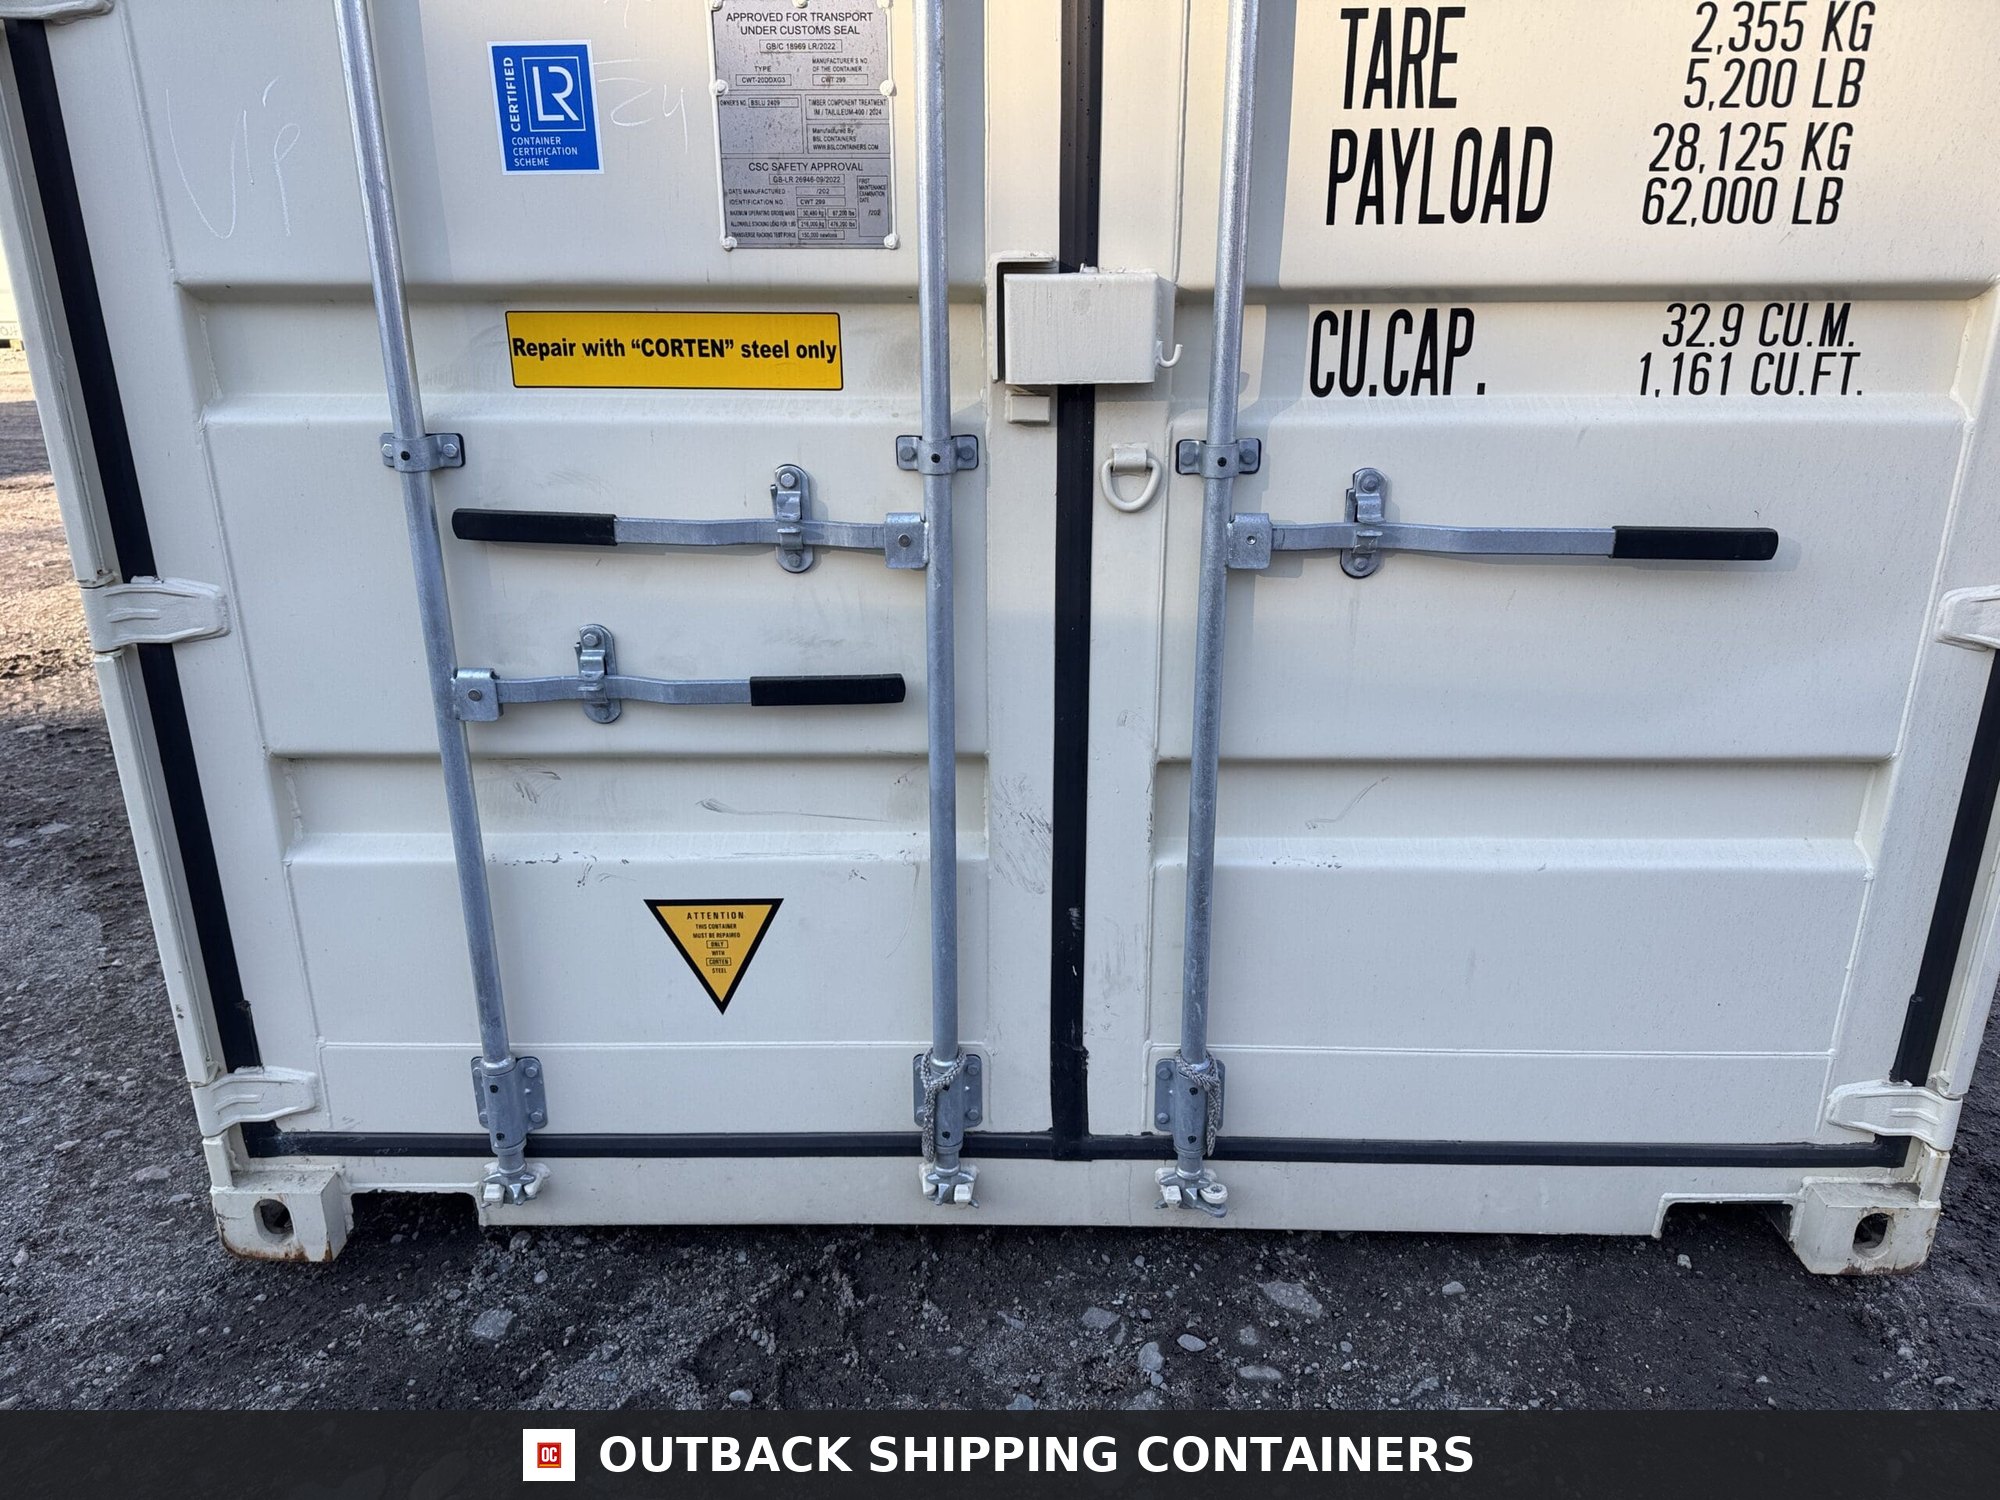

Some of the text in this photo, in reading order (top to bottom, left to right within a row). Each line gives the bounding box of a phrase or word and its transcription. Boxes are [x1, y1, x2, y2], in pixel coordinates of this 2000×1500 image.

[726, 12, 873, 22] APPROVED FOR TRANSPORT
[740, 26, 860, 35] UNDER CUSTOMS SEAL
[1691, 0, 1876, 55] 2,355 KG
[1340, 6, 1466, 110] TARE
[503, 57, 521, 132] CERTIFIED
[532, 66, 580, 121] LR
[1684, 58, 1864, 111] 5,200 LB
[512, 136, 561, 146] CONTAINER
[513, 147, 578, 156] CERTIFICATION
[514, 157, 549, 167] SCHEME
[1648, 122, 1854, 174] 28,125 KG
[748, 162, 863, 171] CSC SAFETY APPROVAL
[1325, 126, 1553, 226] PAYLOAD
[1642, 177, 1844, 227] 62,000 LB
[1662, 302, 1854, 348] 32.9 CU.M.
[512, 337, 575, 361] Repair
[582, 338, 625, 358] with
[741, 340, 789, 359] steel
[796, 340, 837, 364] only
[1640, 351, 1862, 398] 1,161 CU.FT.
[686, 912, 744, 920] ATTENTION
